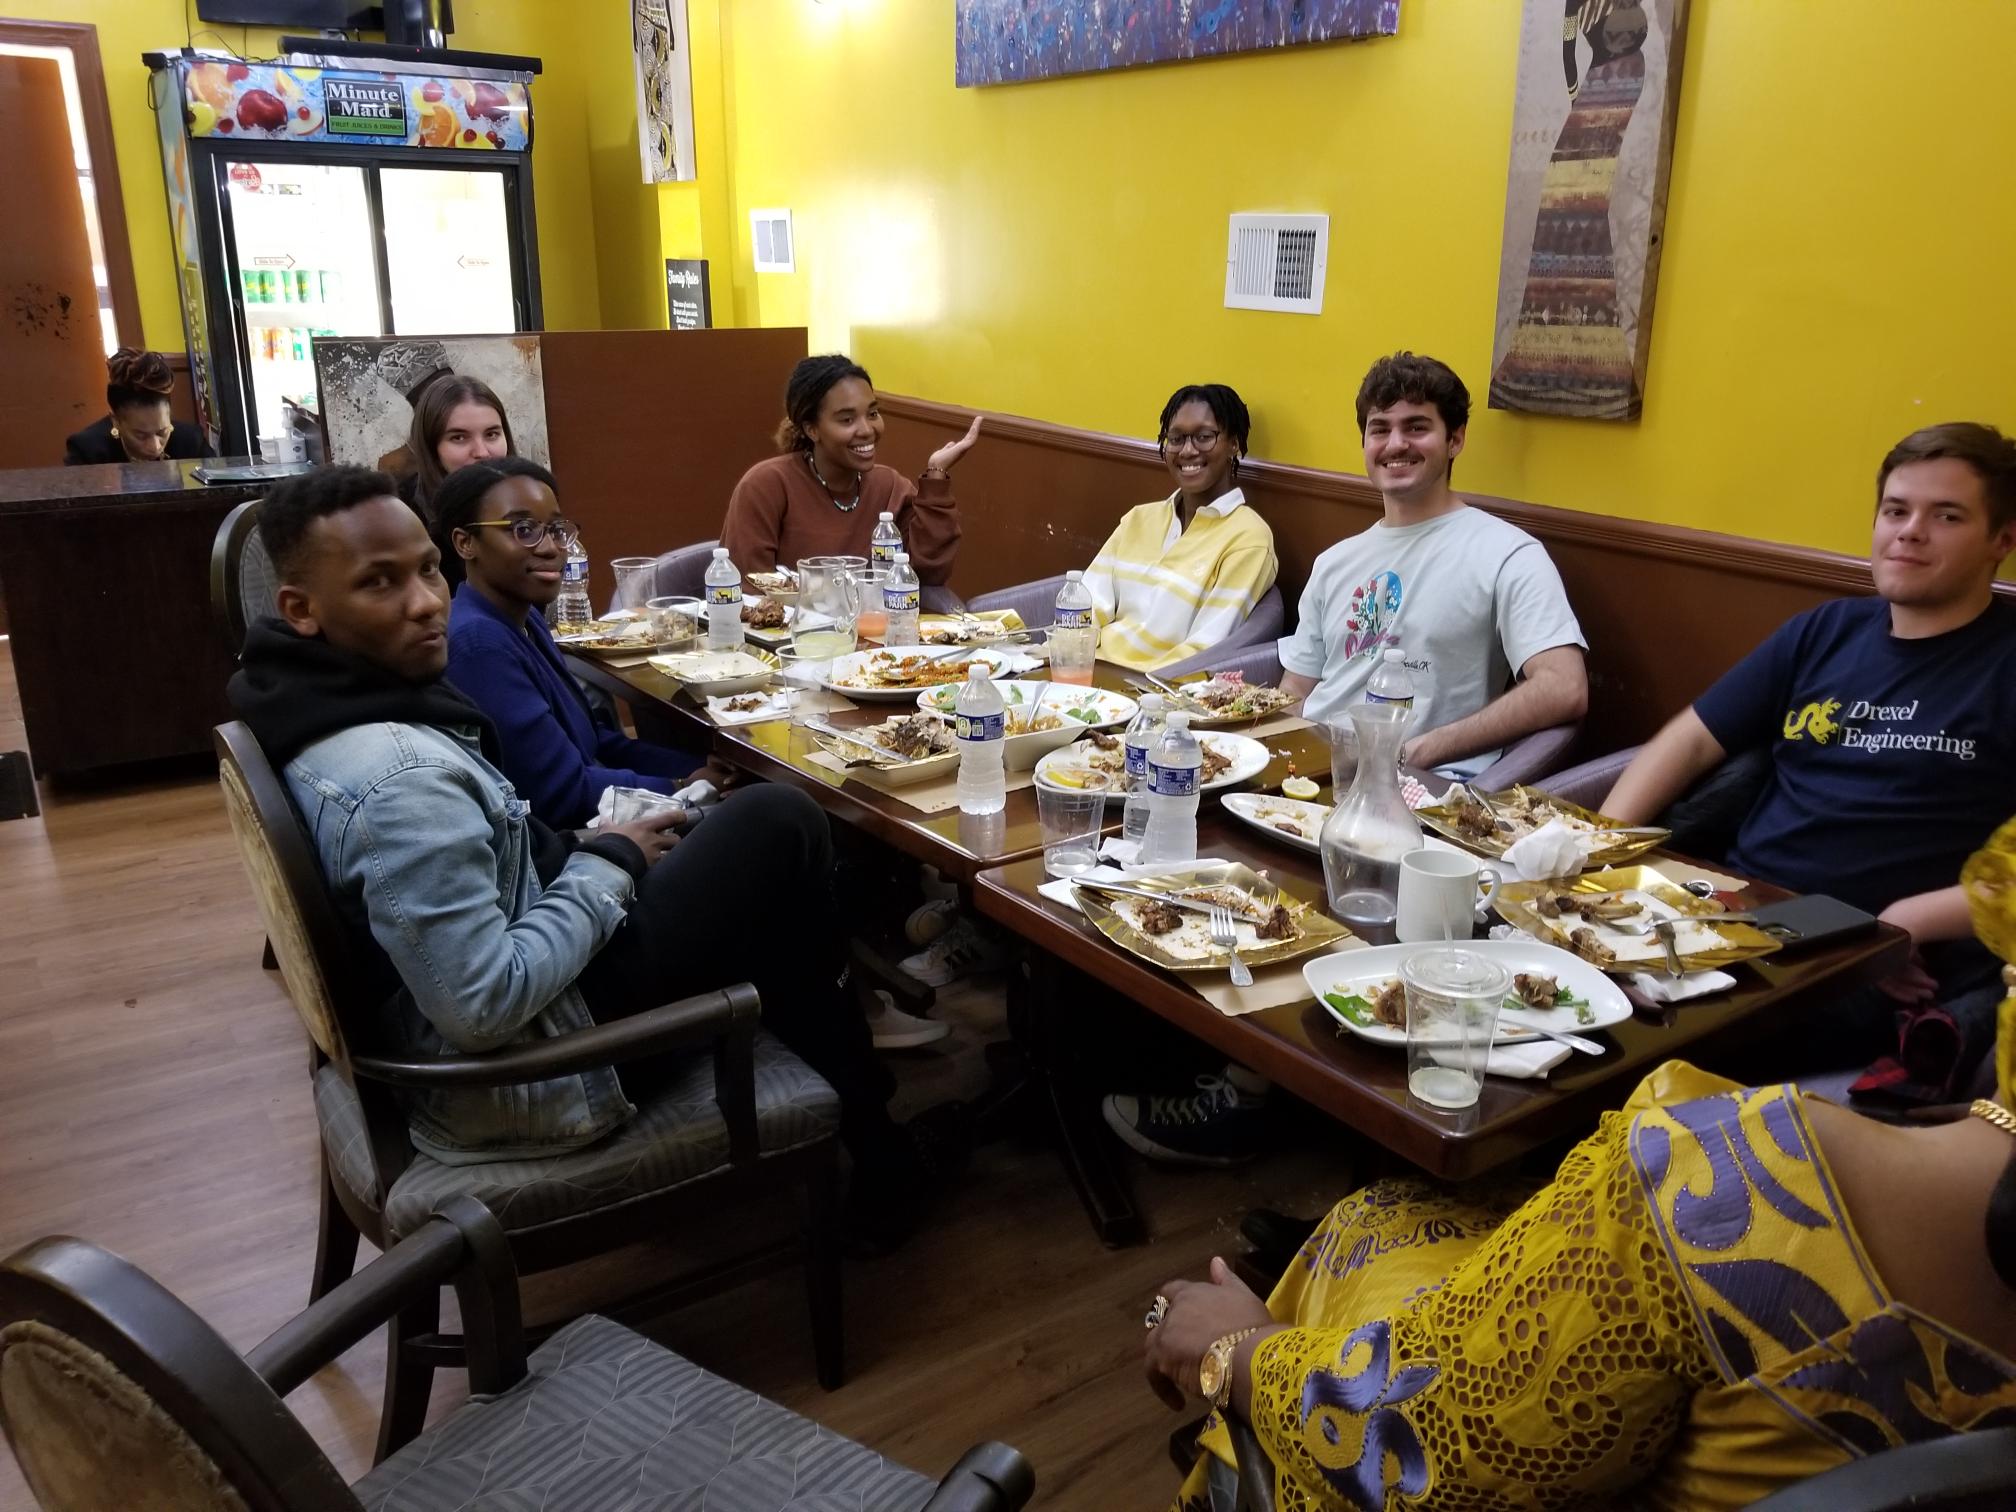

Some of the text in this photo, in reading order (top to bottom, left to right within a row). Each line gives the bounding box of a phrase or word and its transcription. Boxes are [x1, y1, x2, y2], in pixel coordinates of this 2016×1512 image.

[327, 82, 400, 101] Minute
[340, 100, 391, 118] Maid
[1847, 700, 1919, 721] Drexel
[1841, 727, 1977, 760] Engineering
